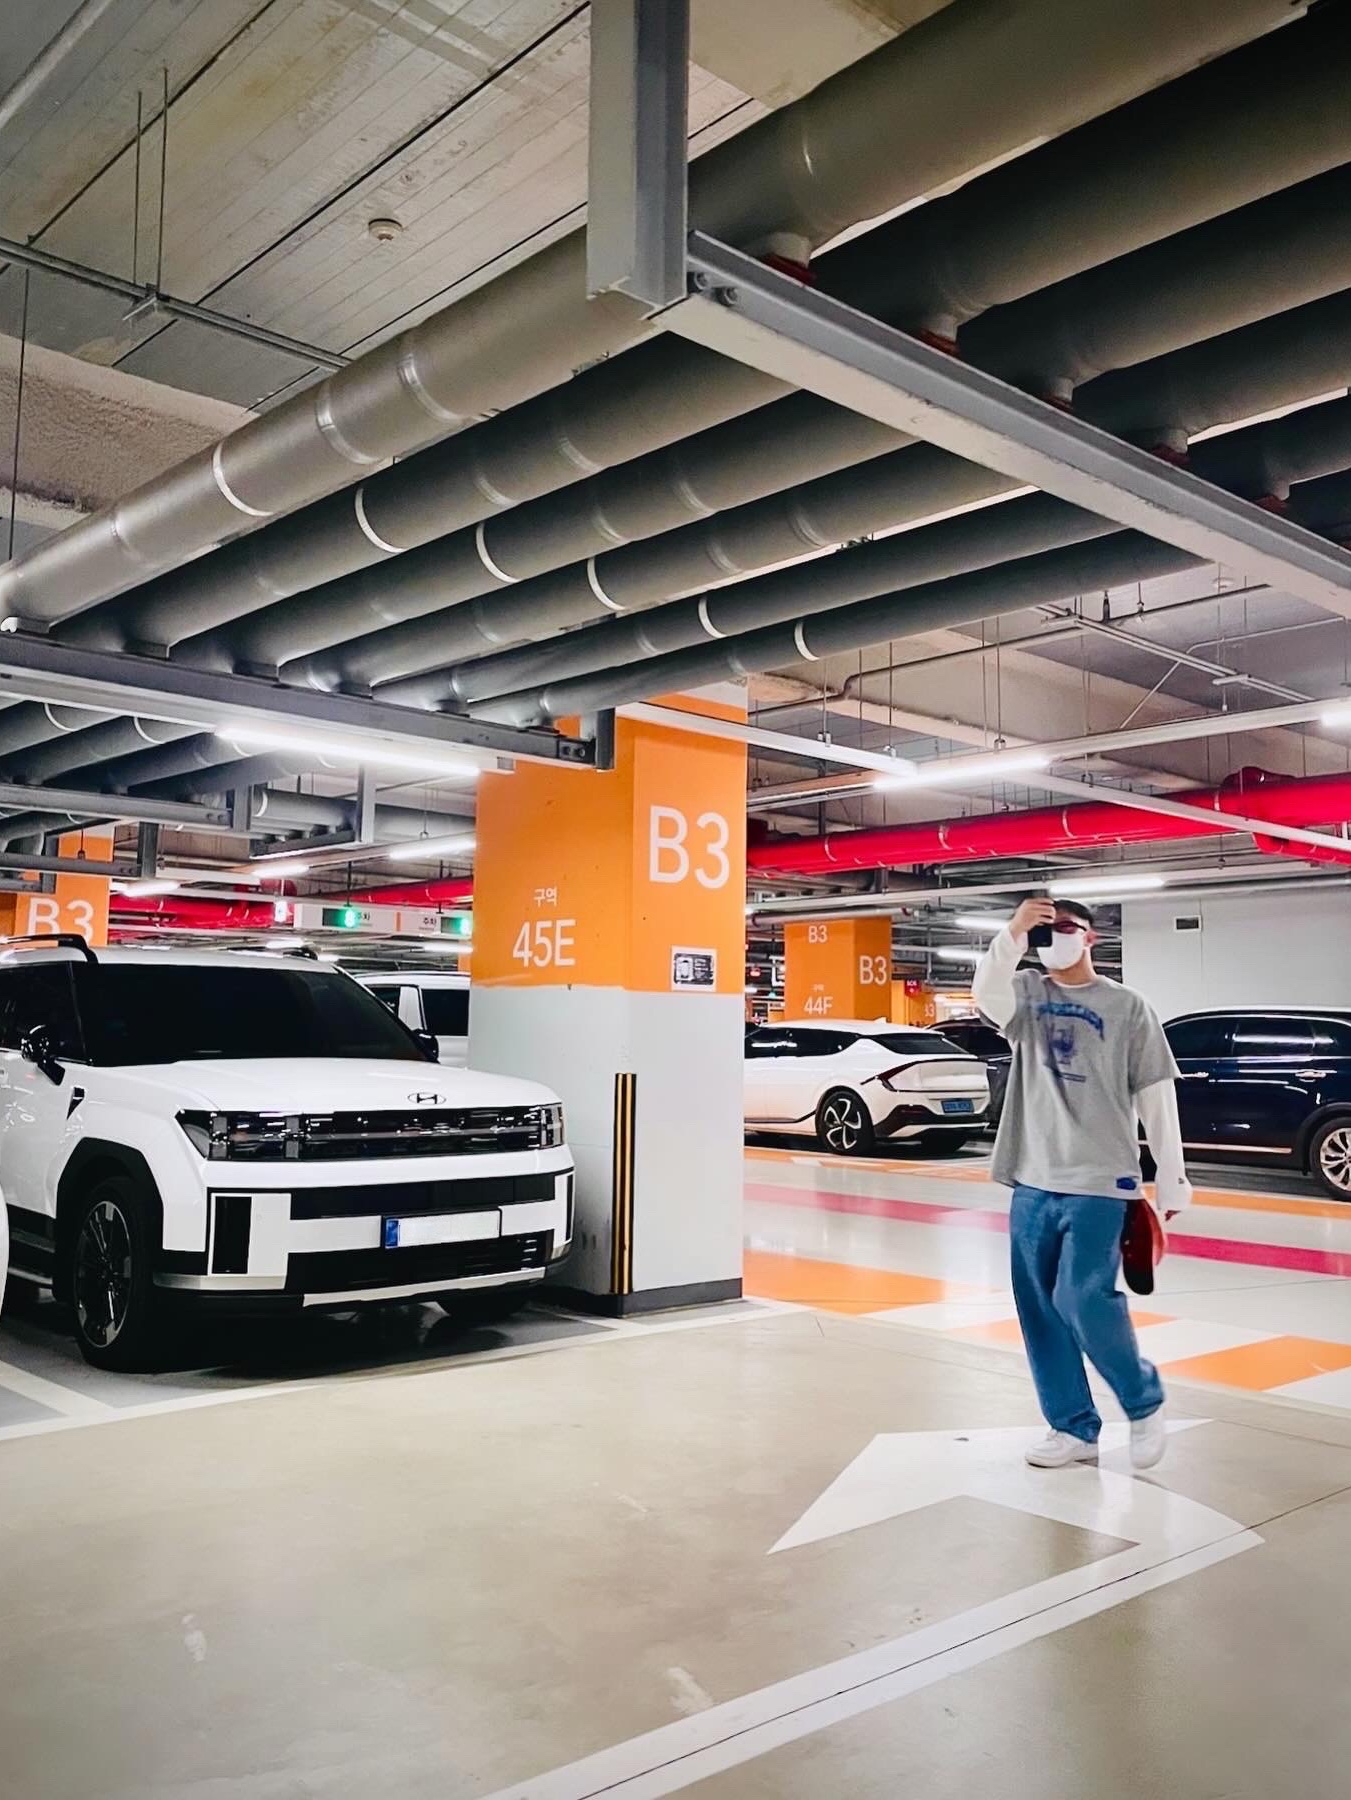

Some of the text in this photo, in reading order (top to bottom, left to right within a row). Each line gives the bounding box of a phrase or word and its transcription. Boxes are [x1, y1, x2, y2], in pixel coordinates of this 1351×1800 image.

[649, 805, 731, 889] B3
[533, 886, 558, 907] 구역
[28, 897, 94, 946] B3
[808, 925, 828, 944] B3
[512, 919, 577, 968] 45E
[859, 955, 888, 985] B3
[803, 996, 834, 1015] 44F
